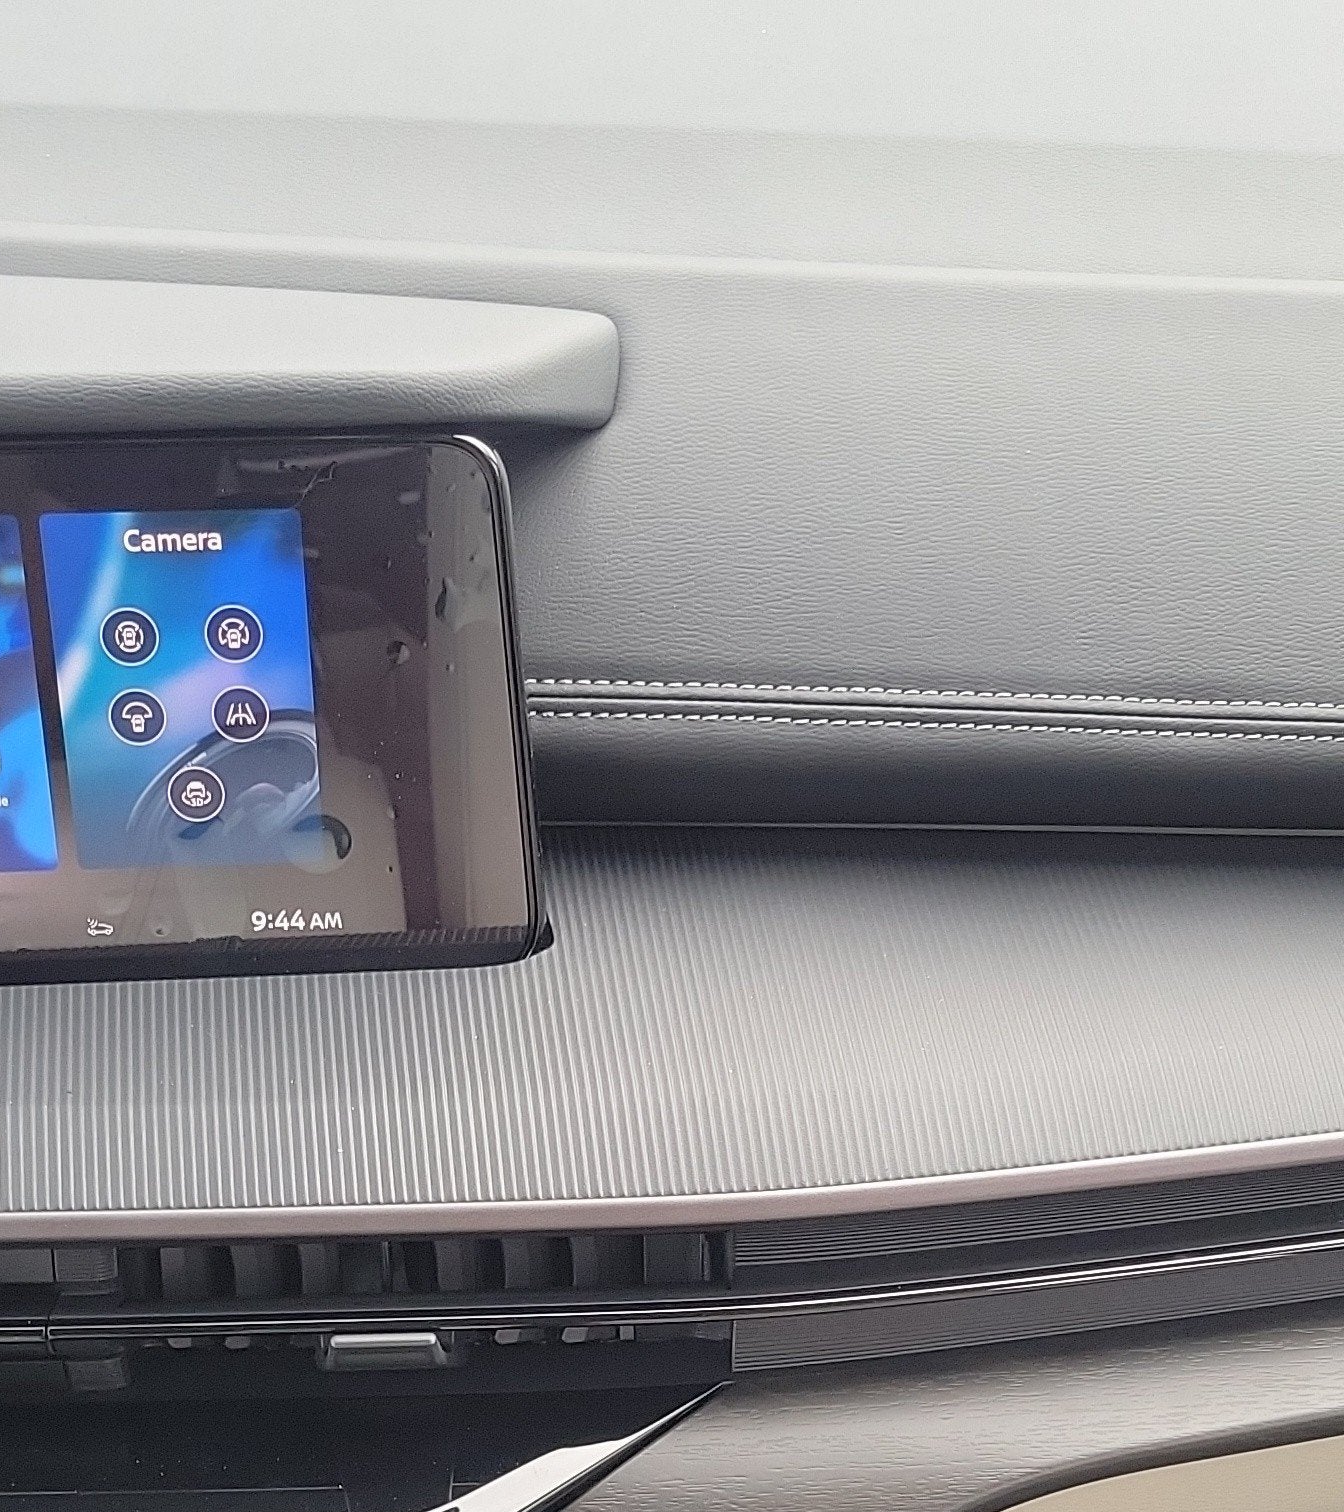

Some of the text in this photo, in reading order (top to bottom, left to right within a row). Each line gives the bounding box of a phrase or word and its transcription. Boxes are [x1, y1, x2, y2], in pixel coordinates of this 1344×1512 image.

[123, 528, 223, 553] Camera
[251, 909, 343, 932] 9:44 AM
